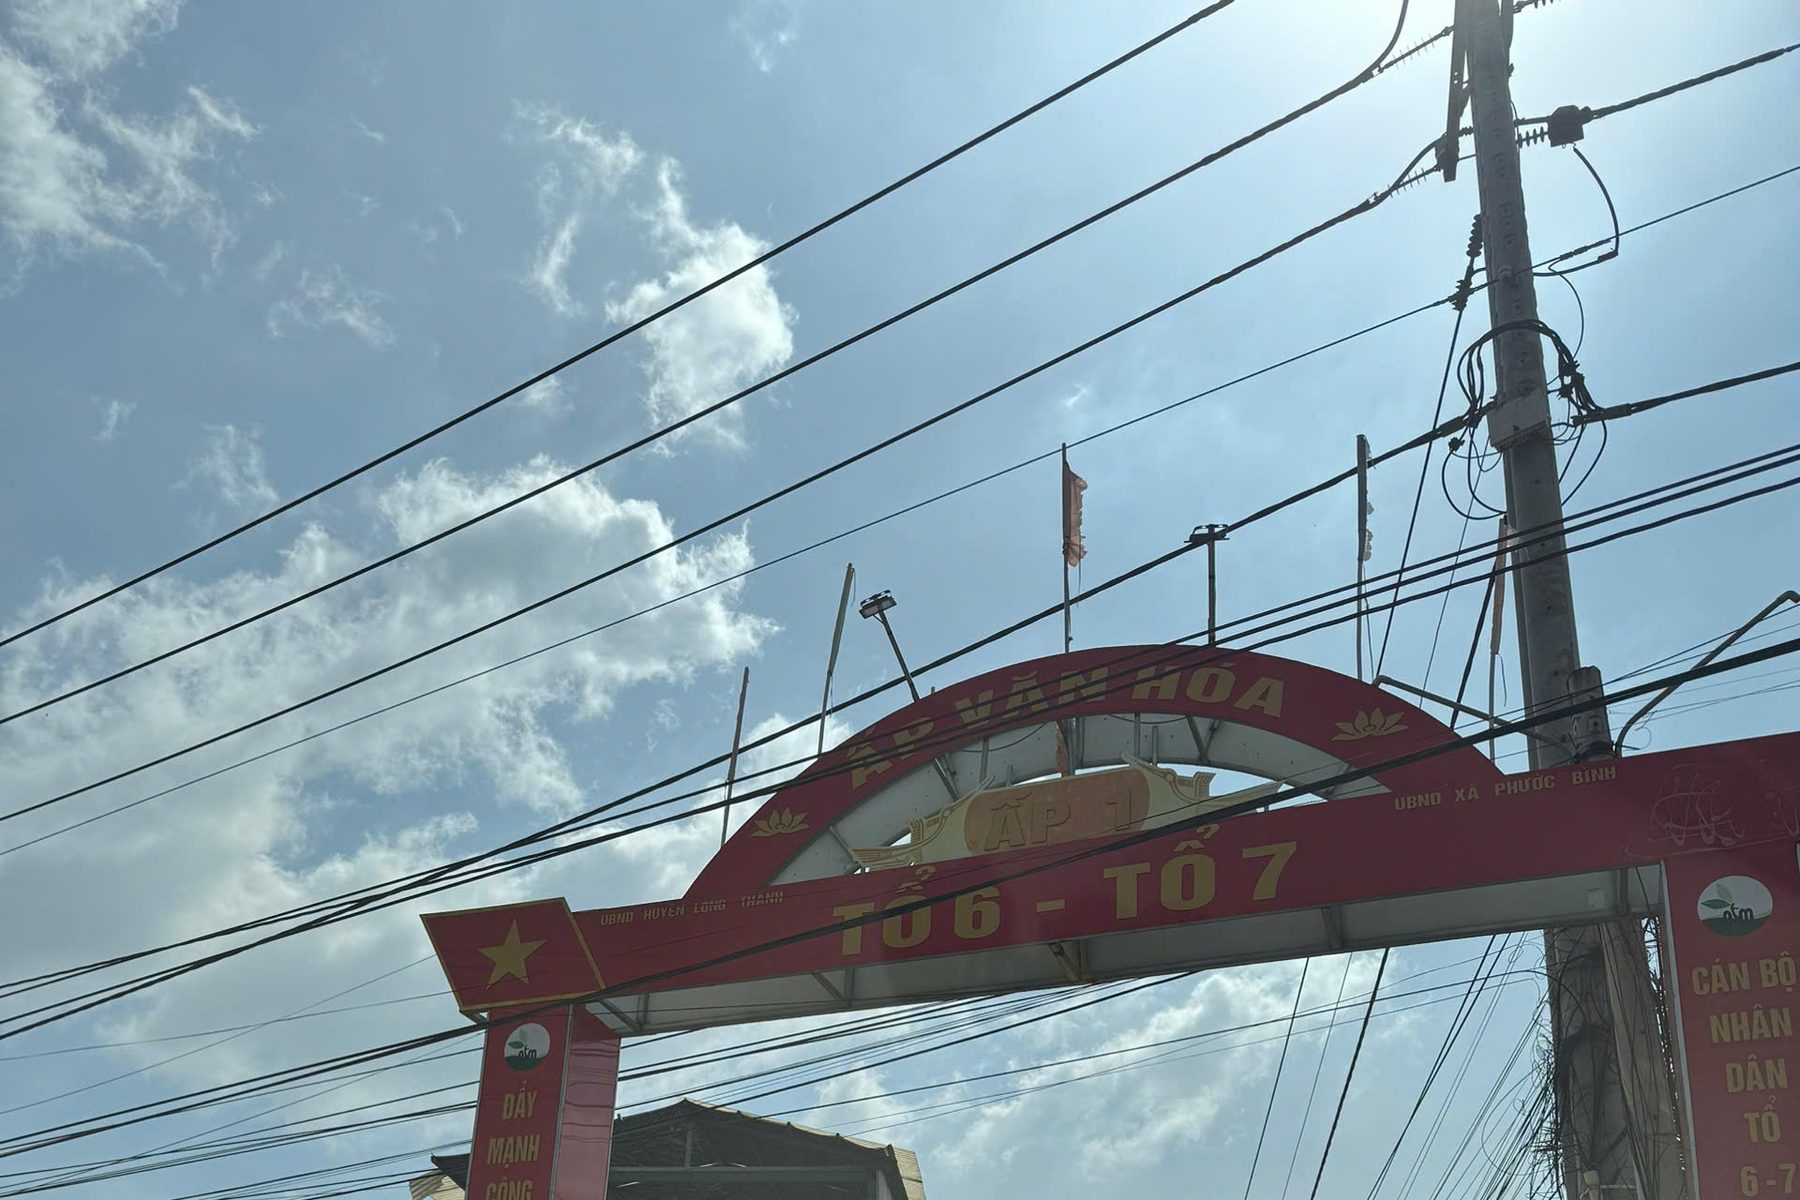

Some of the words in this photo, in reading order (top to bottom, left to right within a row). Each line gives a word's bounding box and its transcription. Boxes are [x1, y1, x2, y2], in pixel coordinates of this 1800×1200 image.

[955, 667, 1109, 730] VĂN
[1132, 662, 1286, 718] HÓA
[983, 790, 1071, 851] ẤP
[1105, 788, 1133, 833] 1
[1394, 792, 1442, 811] UBND
[833, 865, 938, 956] TỔ
[953, 884, 1001, 940] 6
[1103, 823, 1220, 920] TỔ
[1242, 842, 1298, 901] 7
[600, 911, 634, 927] UBND
[1692, 958, 1751, 997] CÁN
[1759, 951, 1798, 993] BỘ
[1709, 1003, 1793, 1044] NHÂN
[1725, 1053, 1788, 1094] DÂN
[502, 1080, 537, 1120] ĐẨY
[1744, 1095, 1782, 1144] TỔ
[487, 1134, 541, 1168] MẠNH
